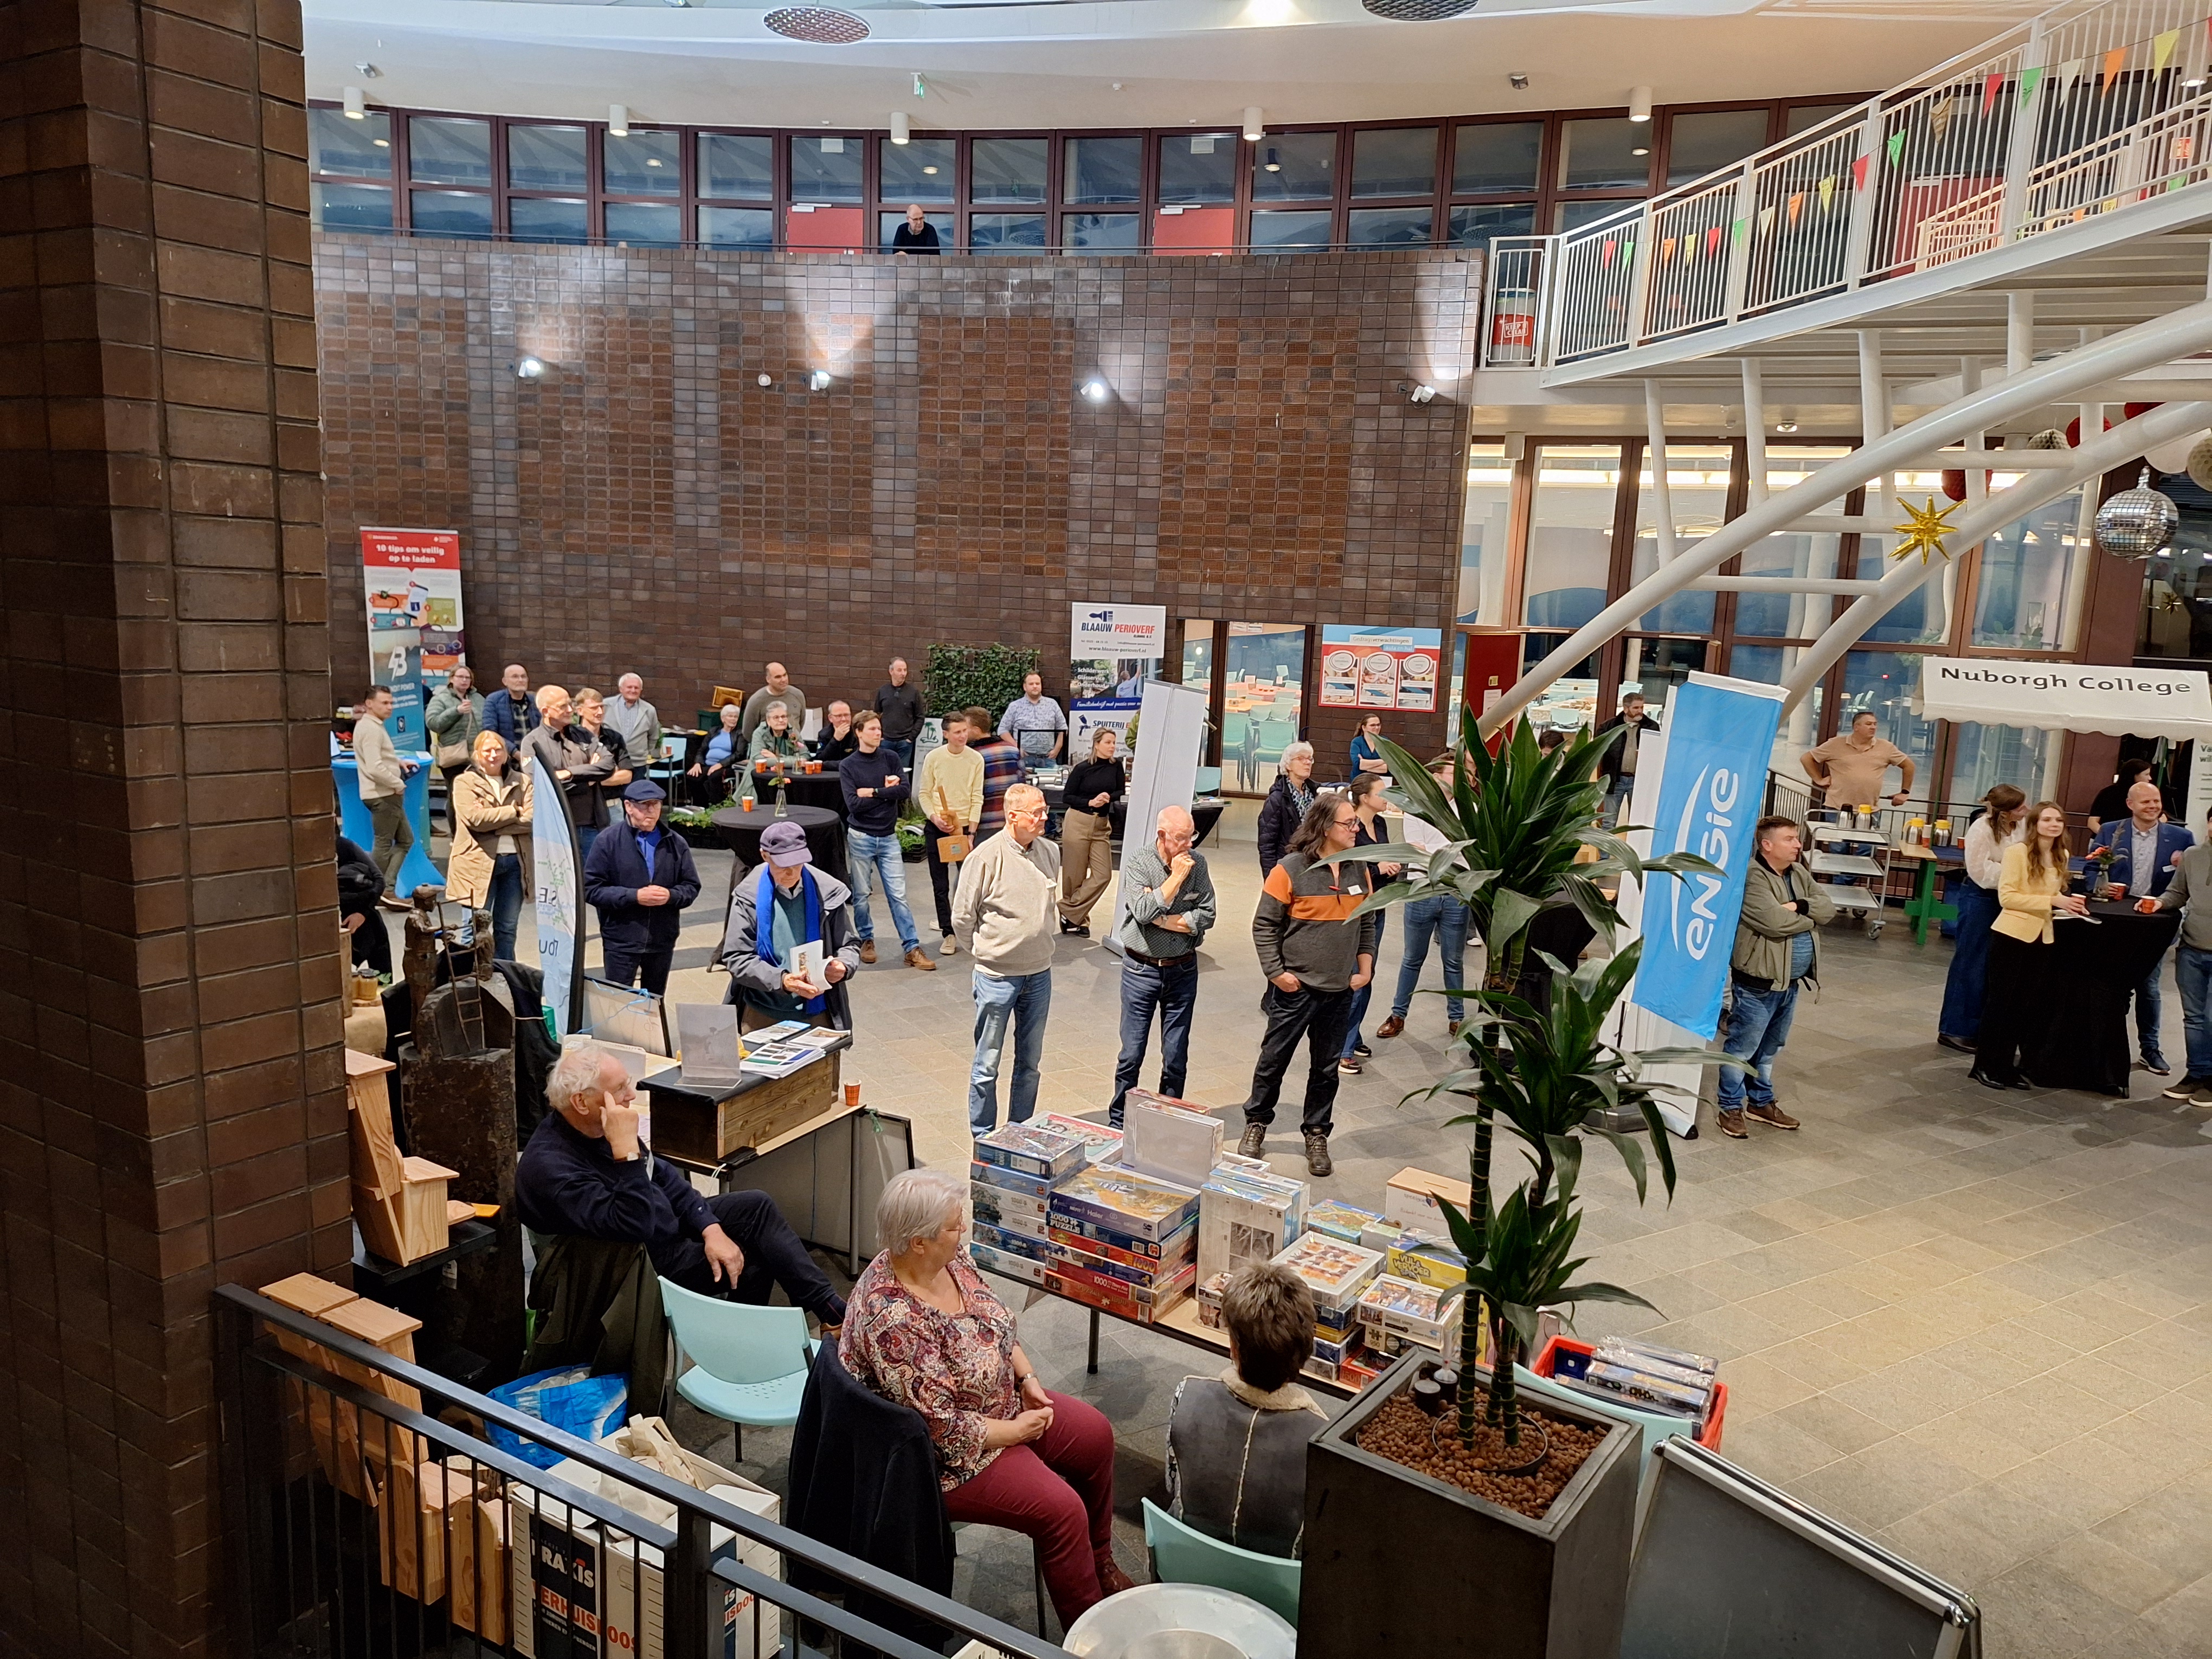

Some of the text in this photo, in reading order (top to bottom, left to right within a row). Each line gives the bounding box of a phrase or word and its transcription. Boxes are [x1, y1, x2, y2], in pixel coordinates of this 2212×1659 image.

[376, 544, 387, 552] 10
[388, 544, 404, 554] tips
[421, 546, 445, 556] veilig
[388, 555, 400, 563] op
[412, 555, 435, 563] laden
[1081, 622, 1155, 634] BLAAUW PERIOVERF
[1353, 636, 1409, 644] Gedragsverwachtingen
[1941, 667, 2191, 696] Nuborgh College
[1092, 720, 1125, 729] SPUITERIJ
[1050, 1212, 1069, 1223] 1000
[1087, 1209, 1103, 1219] Haier
[1050, 1219, 1081, 1234] PUZZLE
[1133, 1256, 1156, 1273] 1000
[1400, 1254, 1416, 1265] VUL
[1393, 1258, 1430, 1277] VERVOER
[1094, 1275, 1108, 1287] 1000
[1386, 1314, 1401, 1323] Street
